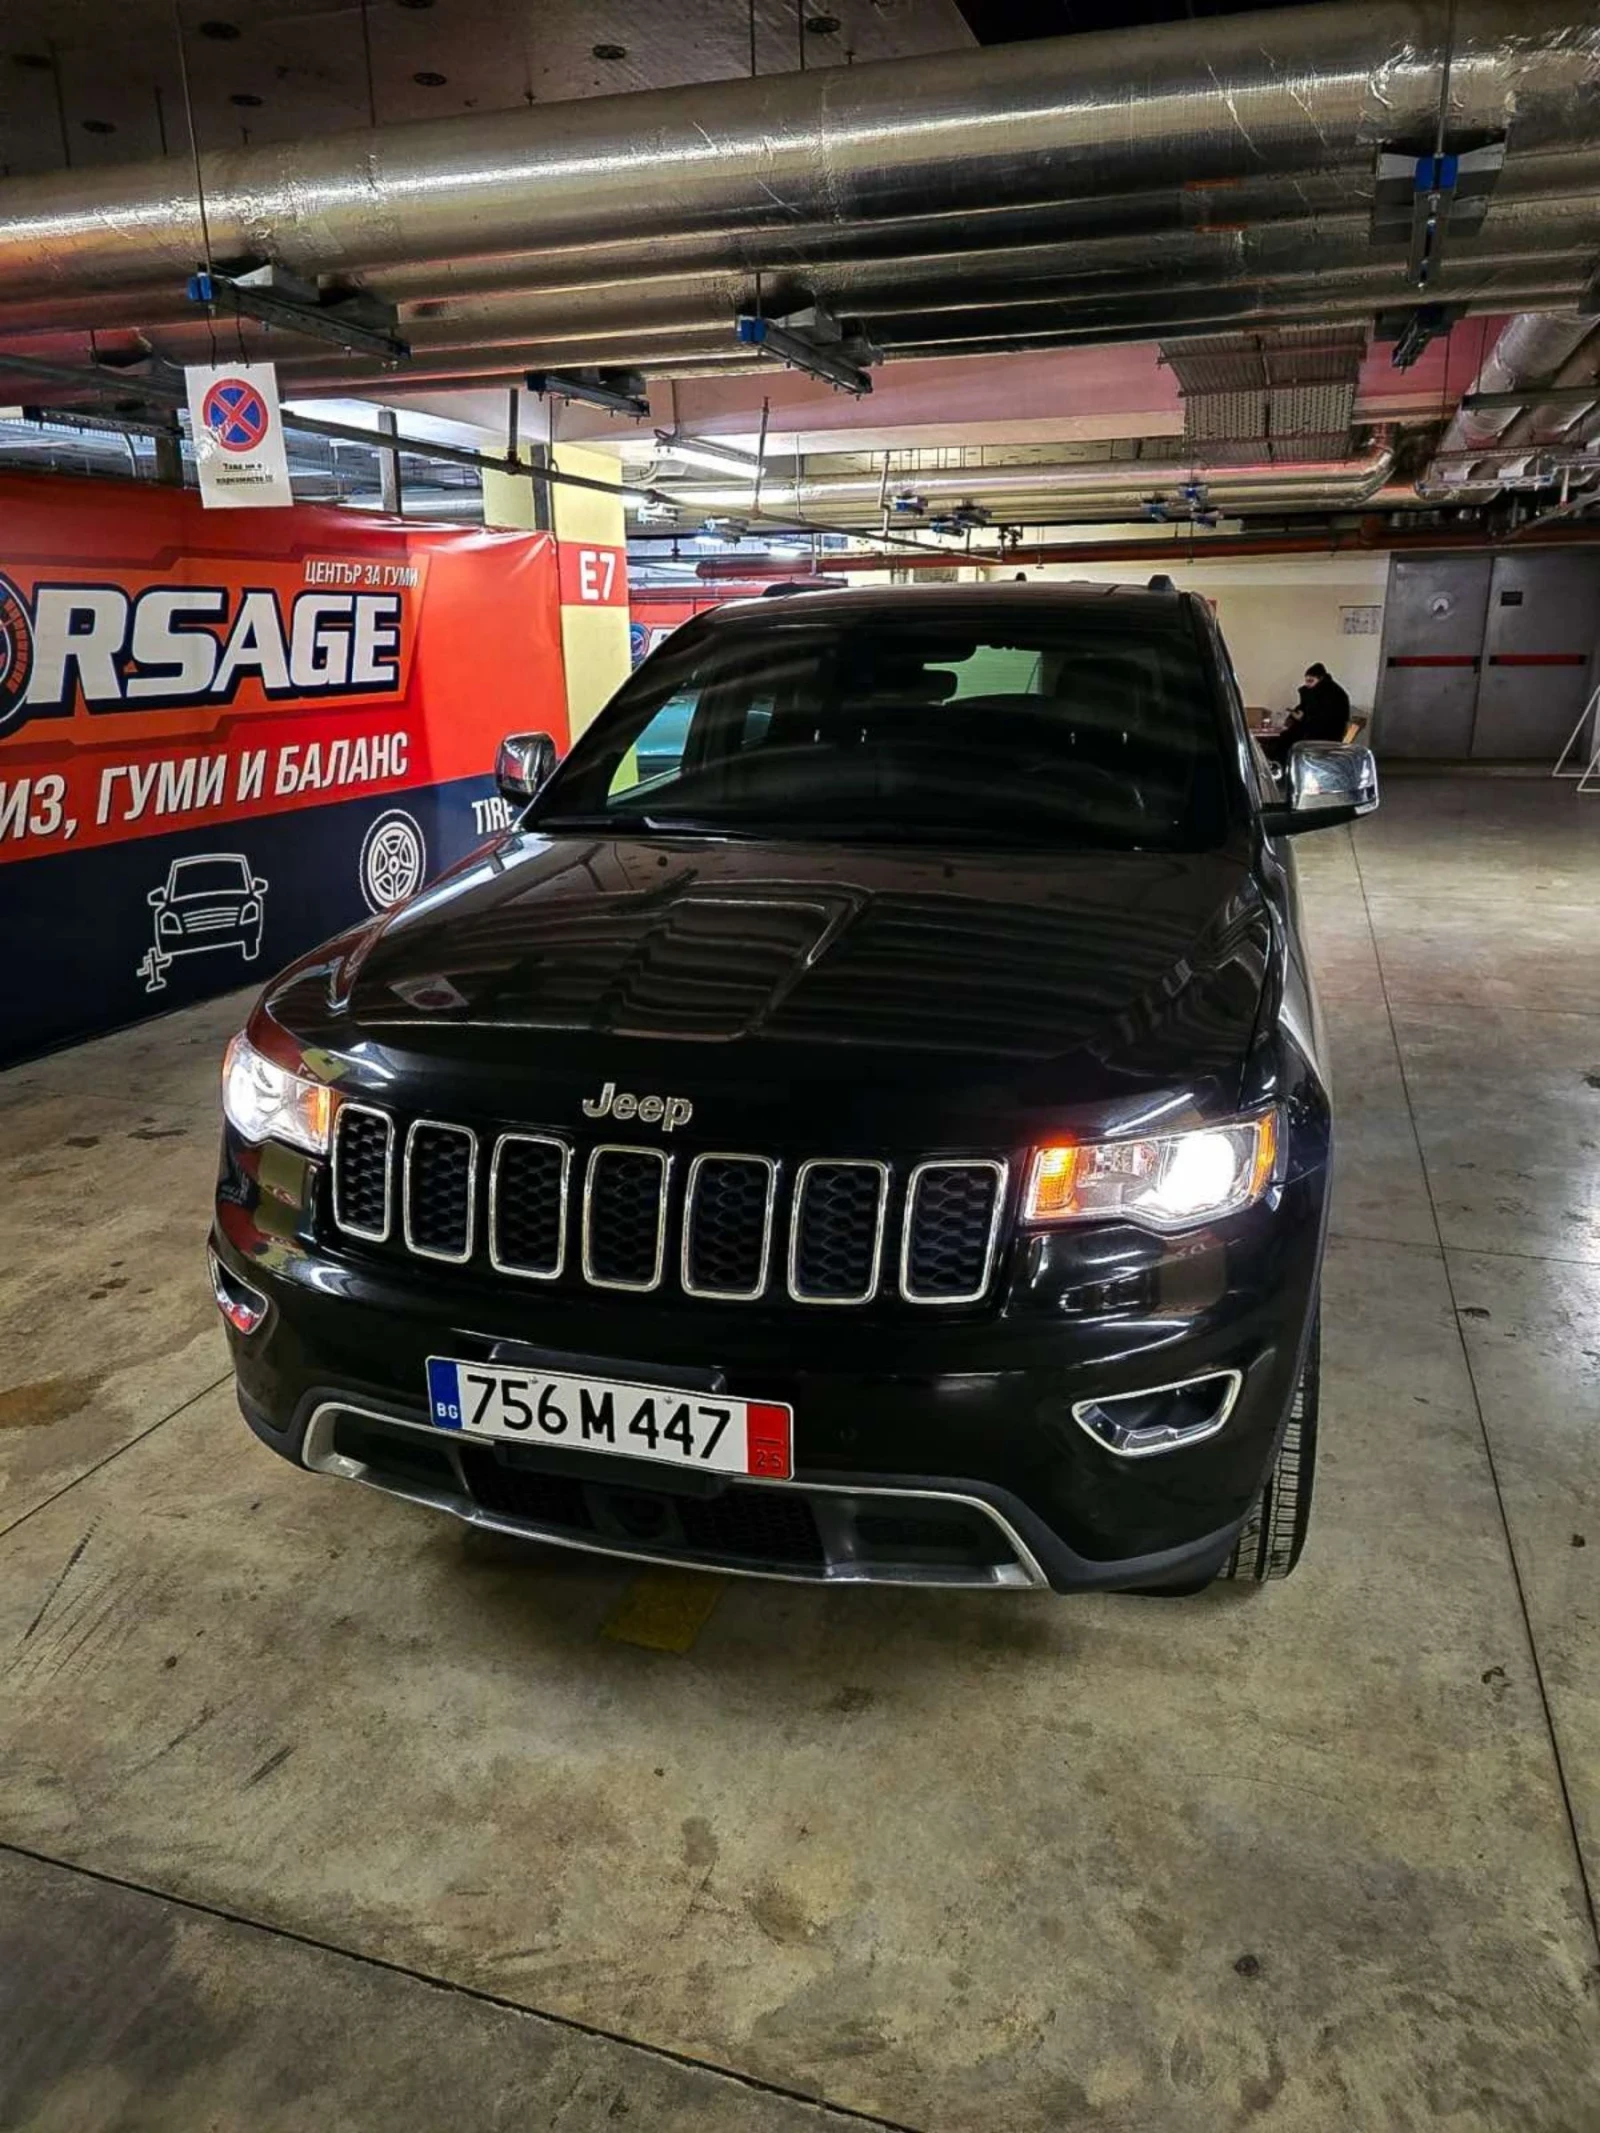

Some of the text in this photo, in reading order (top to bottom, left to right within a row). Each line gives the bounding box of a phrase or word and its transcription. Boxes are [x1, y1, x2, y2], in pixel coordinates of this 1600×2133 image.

[304, 561, 419, 588] ЦЕНТЪР ЗА ГУМИ
[579, 549, 616, 601] E7
[96, 753, 228, 826] ГУМИ
[236, 749, 267, 802] И
[274, 731, 409, 797] БАЛАНС
[582, 1082, 693, 1133] Jeep
[436, 1402, 459, 1420] BG
